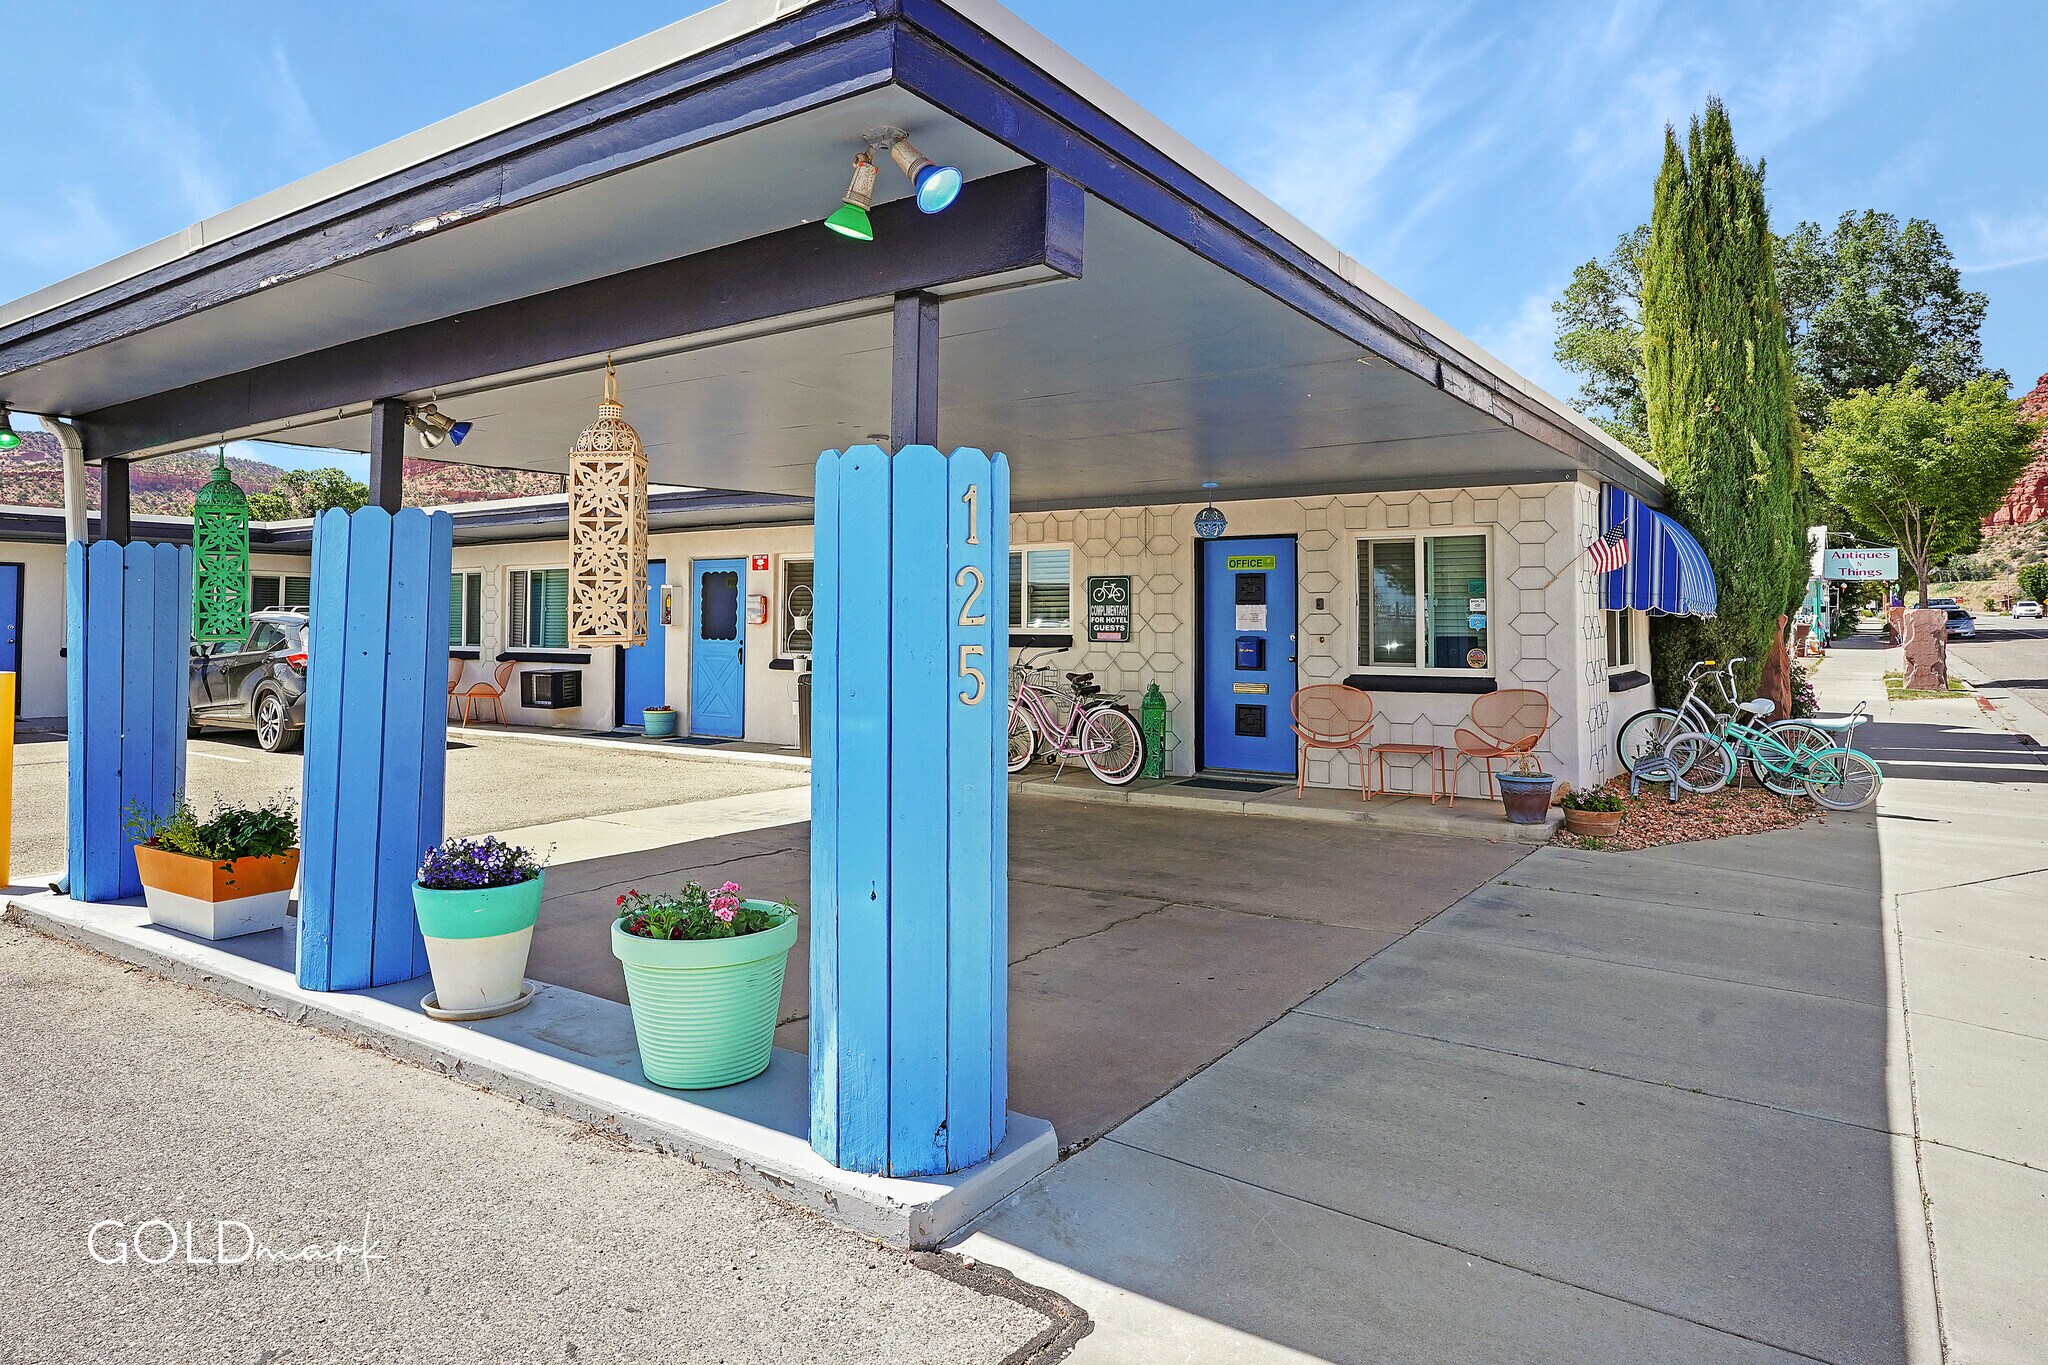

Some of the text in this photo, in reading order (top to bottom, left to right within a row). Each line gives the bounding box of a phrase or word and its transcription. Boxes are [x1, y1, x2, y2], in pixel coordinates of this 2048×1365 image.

[1831, 551, 1890, 560] Antiques
[1229, 559, 1262, 568] OFFICE
[1838, 568, 1883, 577] Things
[1091, 605, 1129, 616] COMPLIMENTARY
